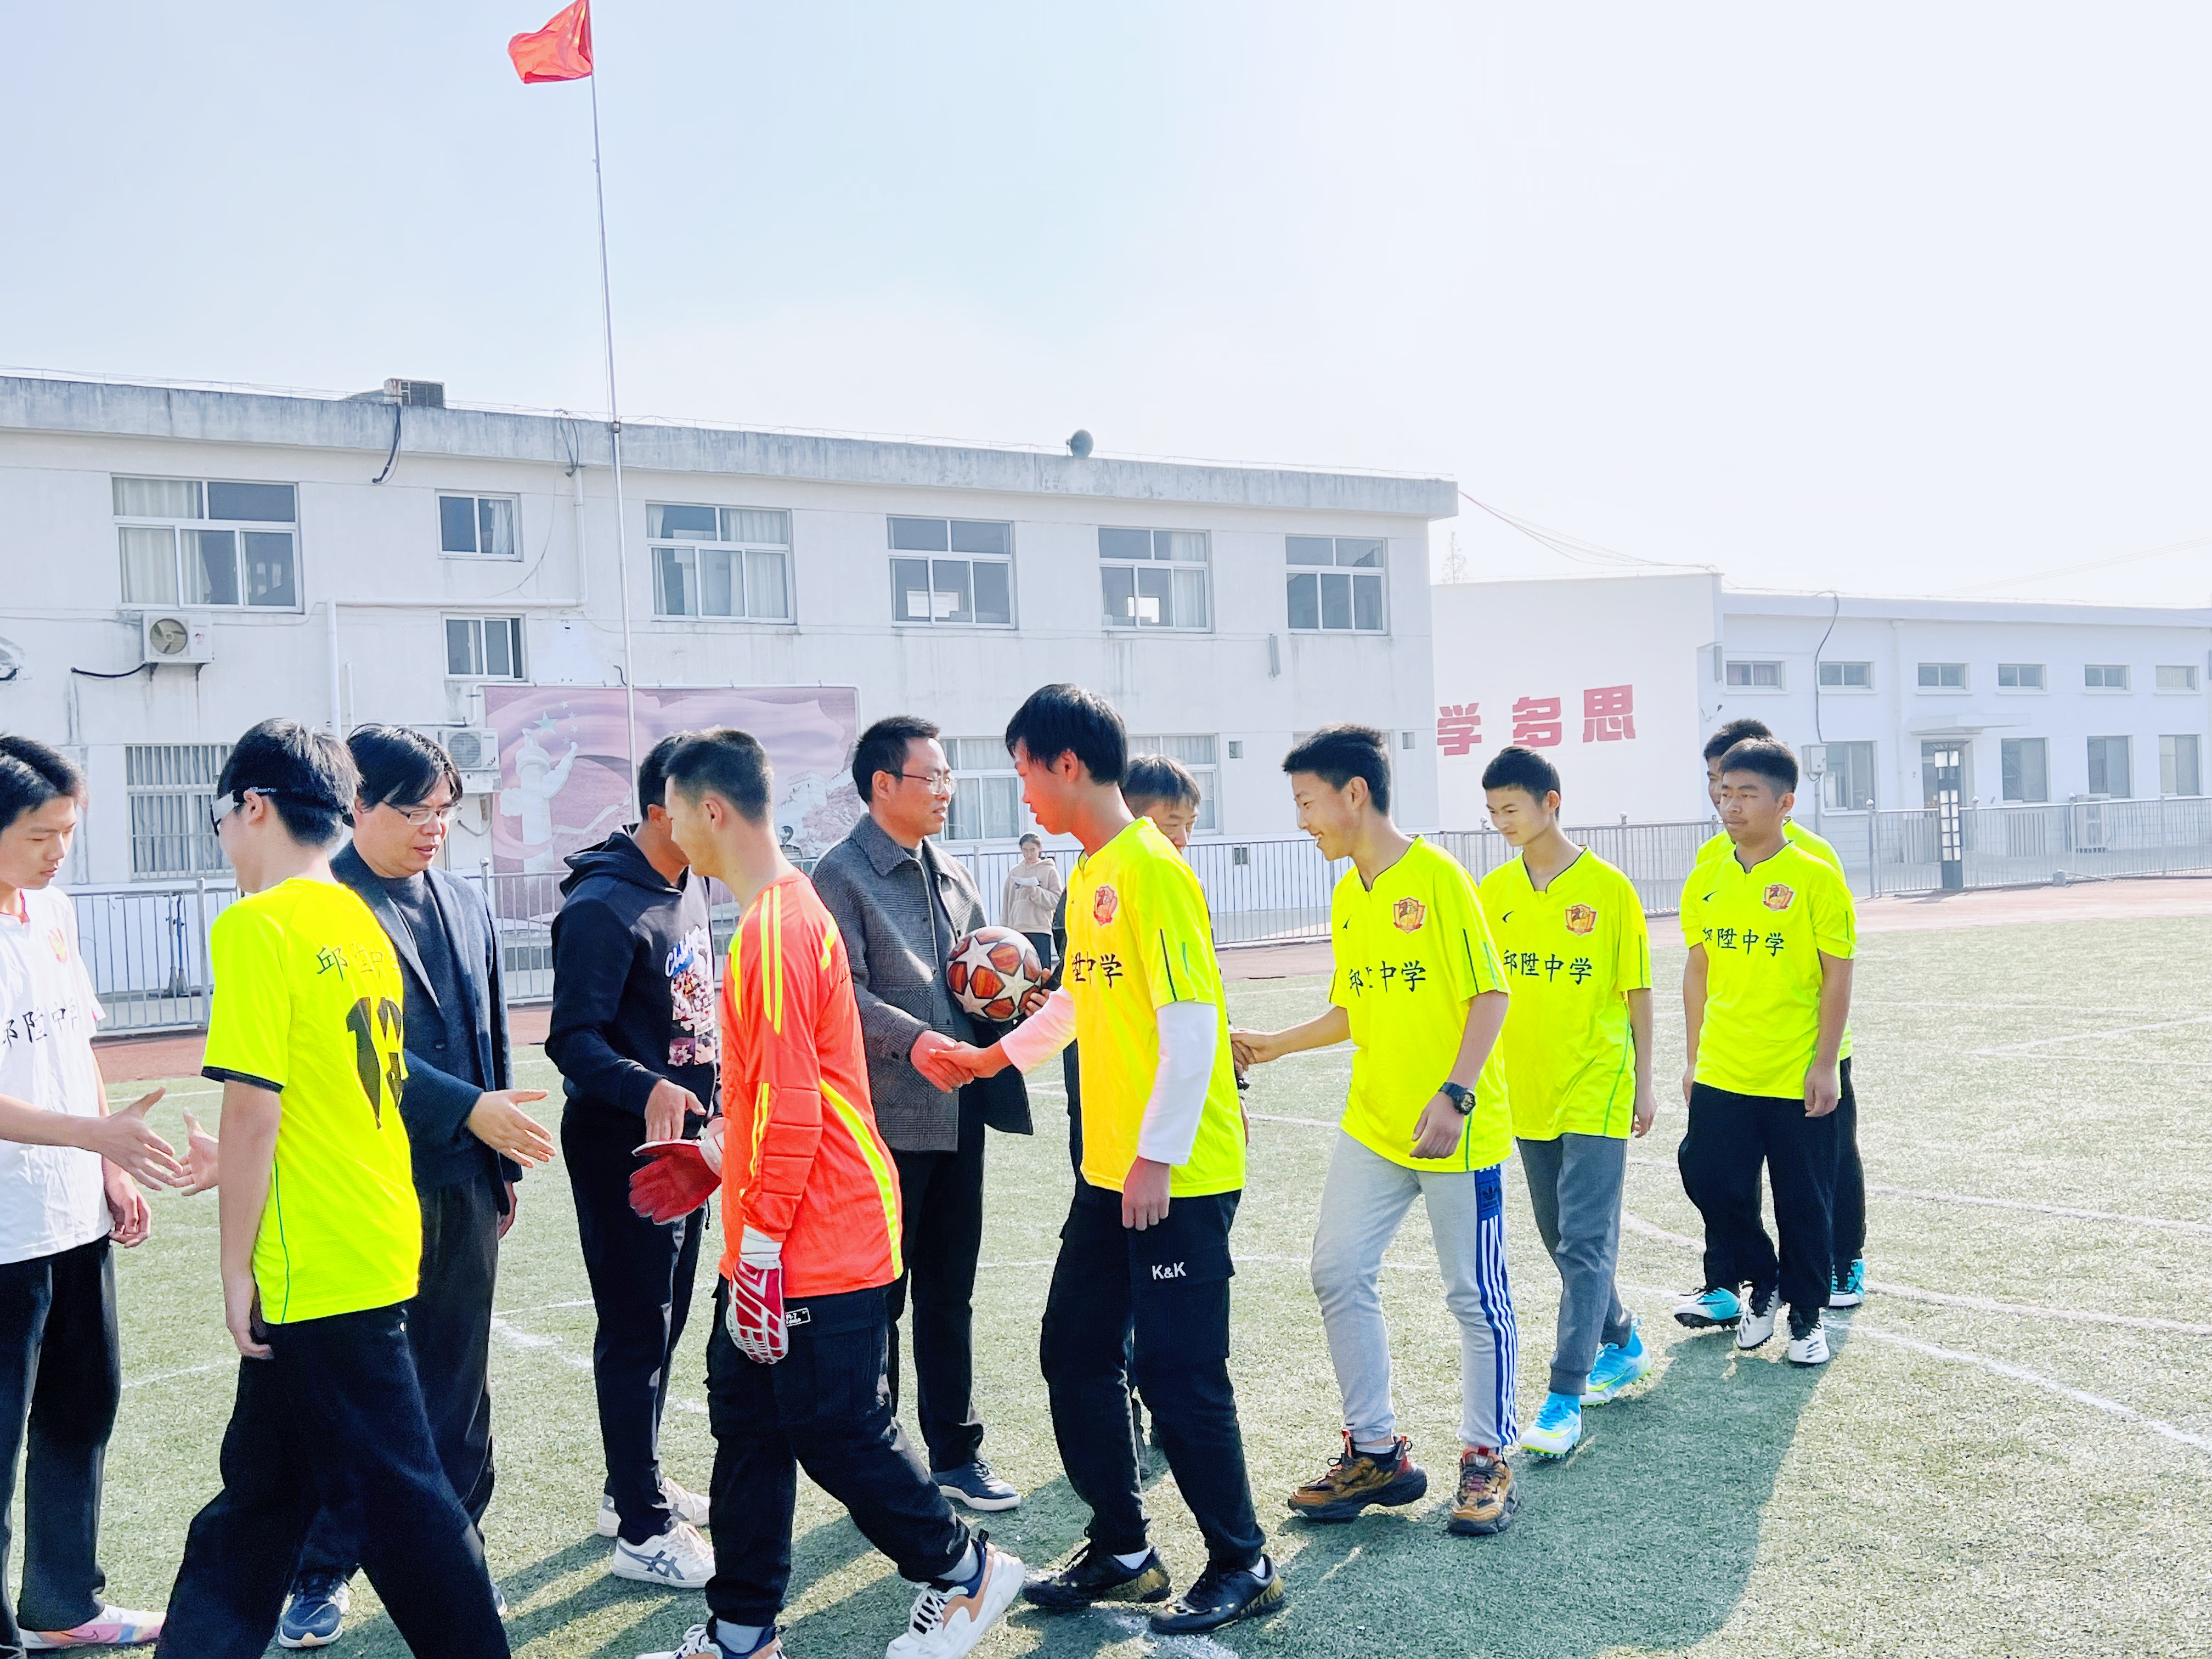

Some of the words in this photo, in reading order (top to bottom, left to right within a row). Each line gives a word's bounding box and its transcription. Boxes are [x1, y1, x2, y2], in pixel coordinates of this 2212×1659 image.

[1437, 684, 1636, 756] 学多思
[1349, 960, 1426, 997] 邱中学
[1152, 1261, 1187, 1280] K&K
